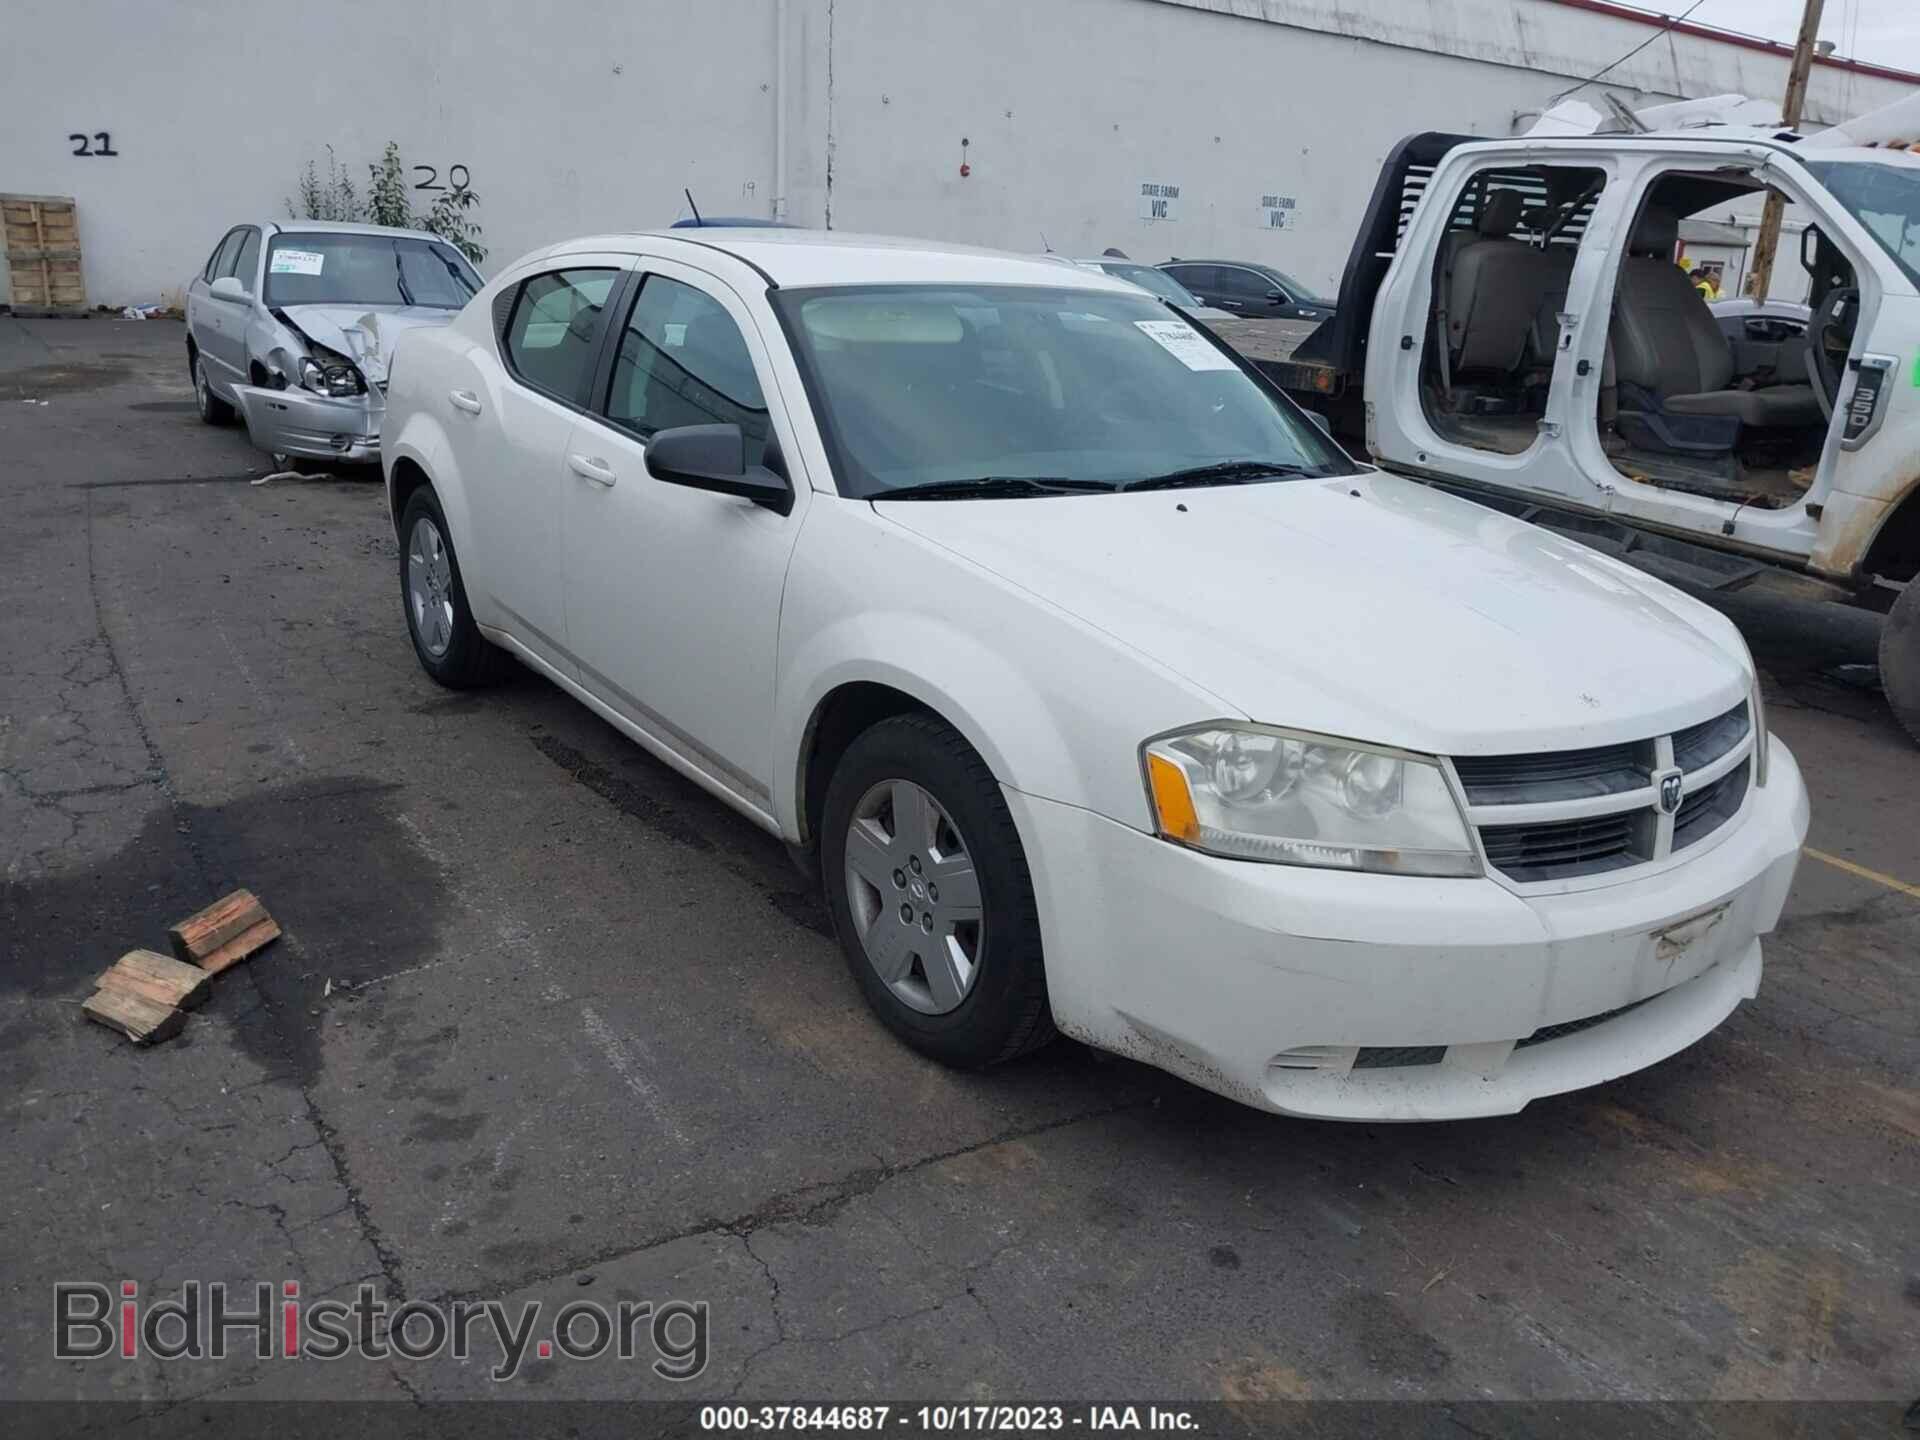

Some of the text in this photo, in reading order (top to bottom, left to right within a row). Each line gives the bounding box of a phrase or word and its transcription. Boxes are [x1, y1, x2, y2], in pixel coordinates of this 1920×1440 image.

[69, 132, 118, 156] 21
[413, 164, 470, 191] 20
[1142, 183, 1179, 198] STATE FARM
[1151, 199, 1168, 218] VIC
[1262, 195, 1278, 208] STATE
[1270, 210, 1285, 228] VIC
